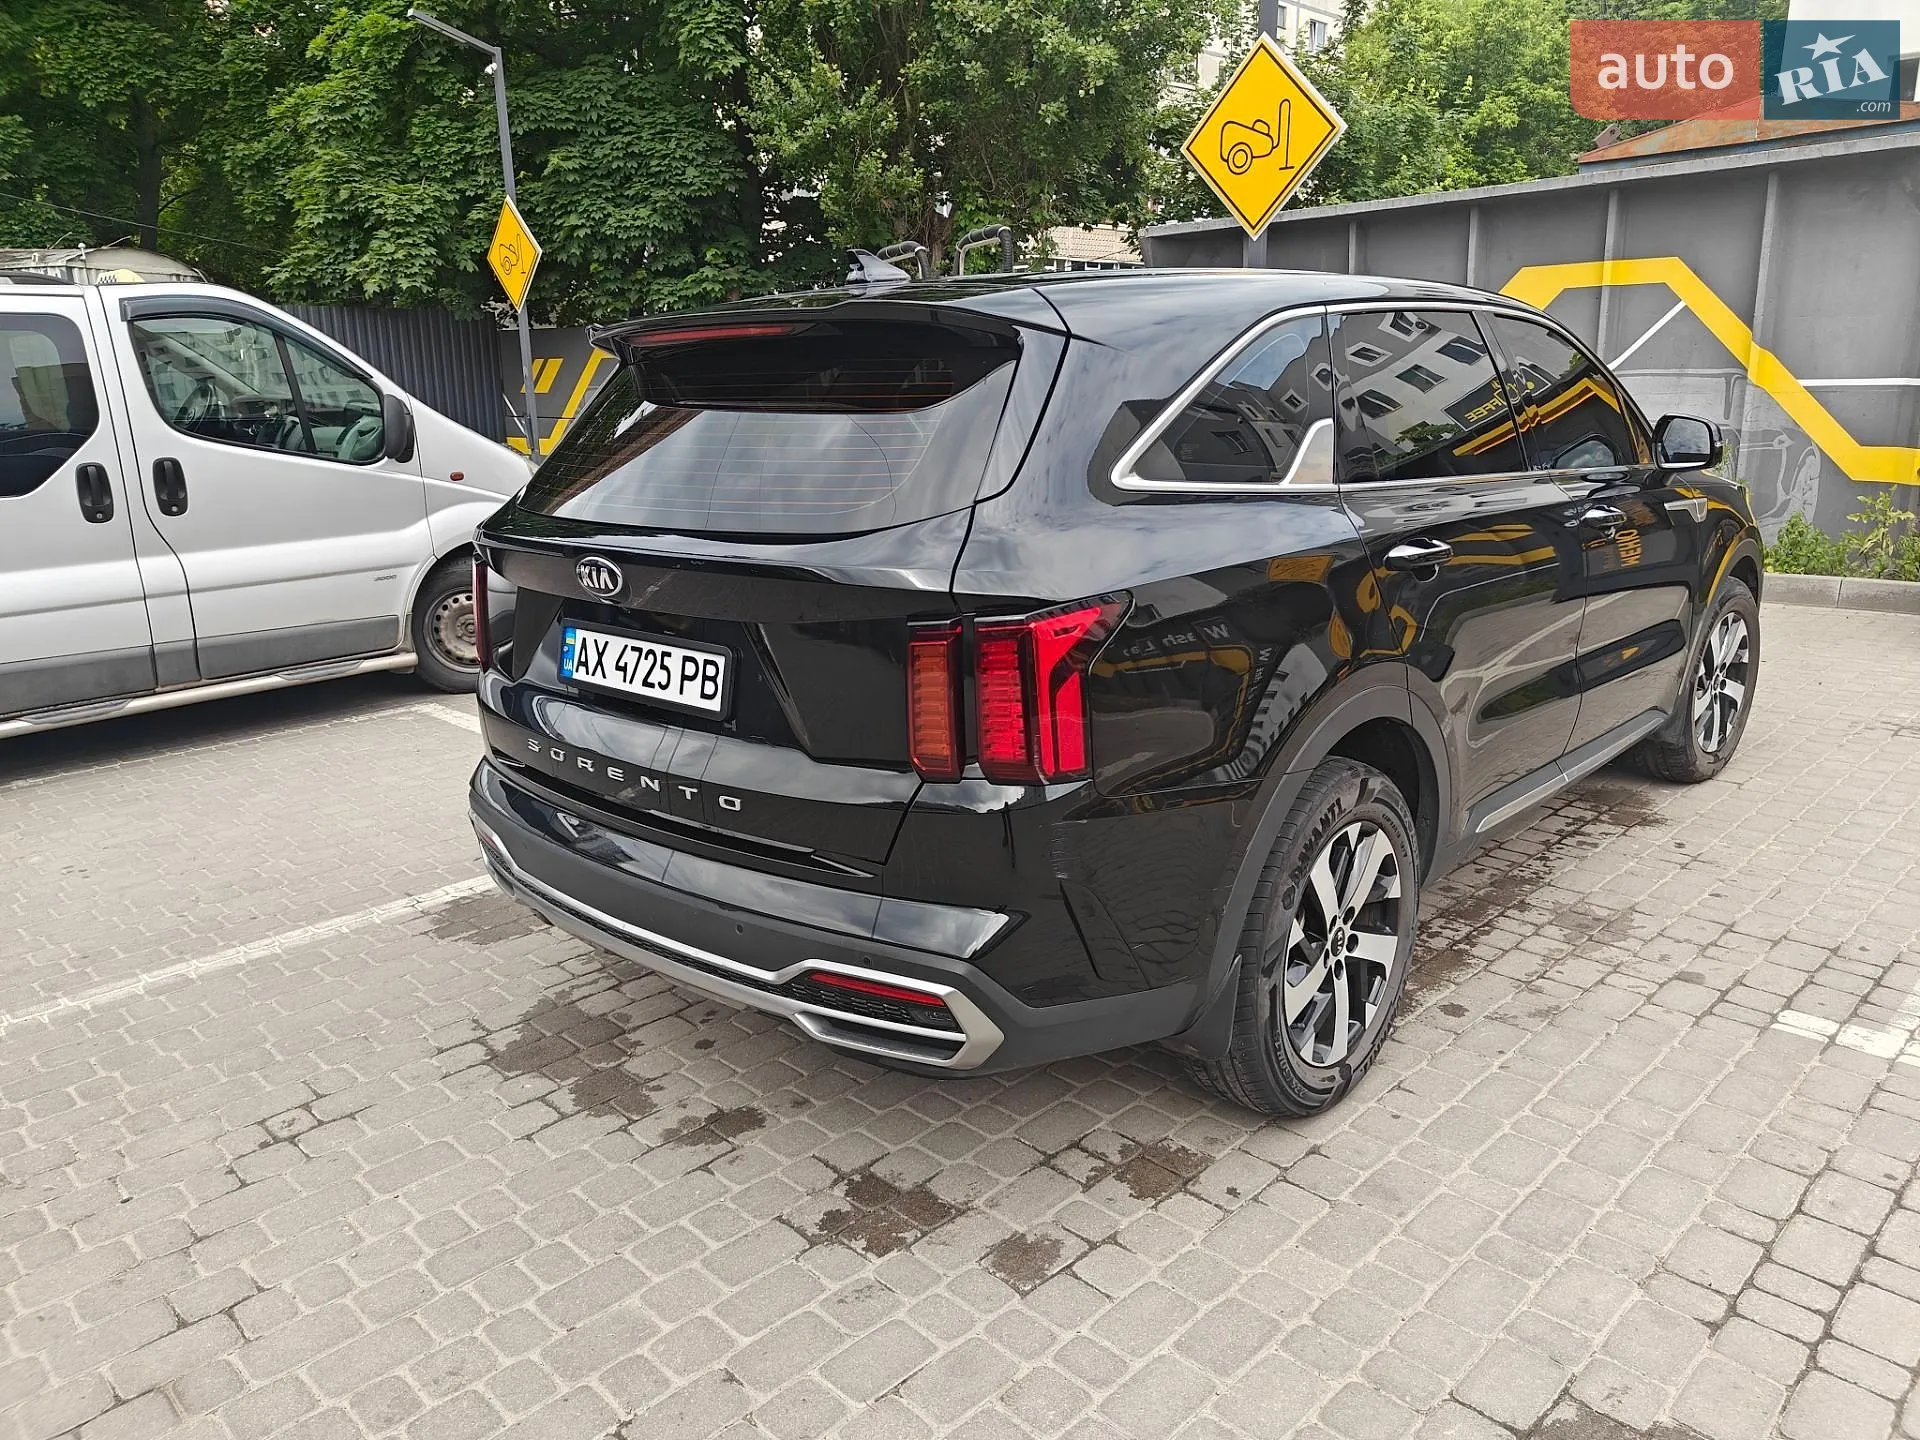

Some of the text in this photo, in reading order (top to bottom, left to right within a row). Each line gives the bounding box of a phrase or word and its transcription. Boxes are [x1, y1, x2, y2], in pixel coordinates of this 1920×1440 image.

[580, 564, 615, 590] KIA
[563, 657, 573, 672] UA
[575, 636, 720, 701] AX 4725 PB
[527, 738, 742, 812] SORENTO
